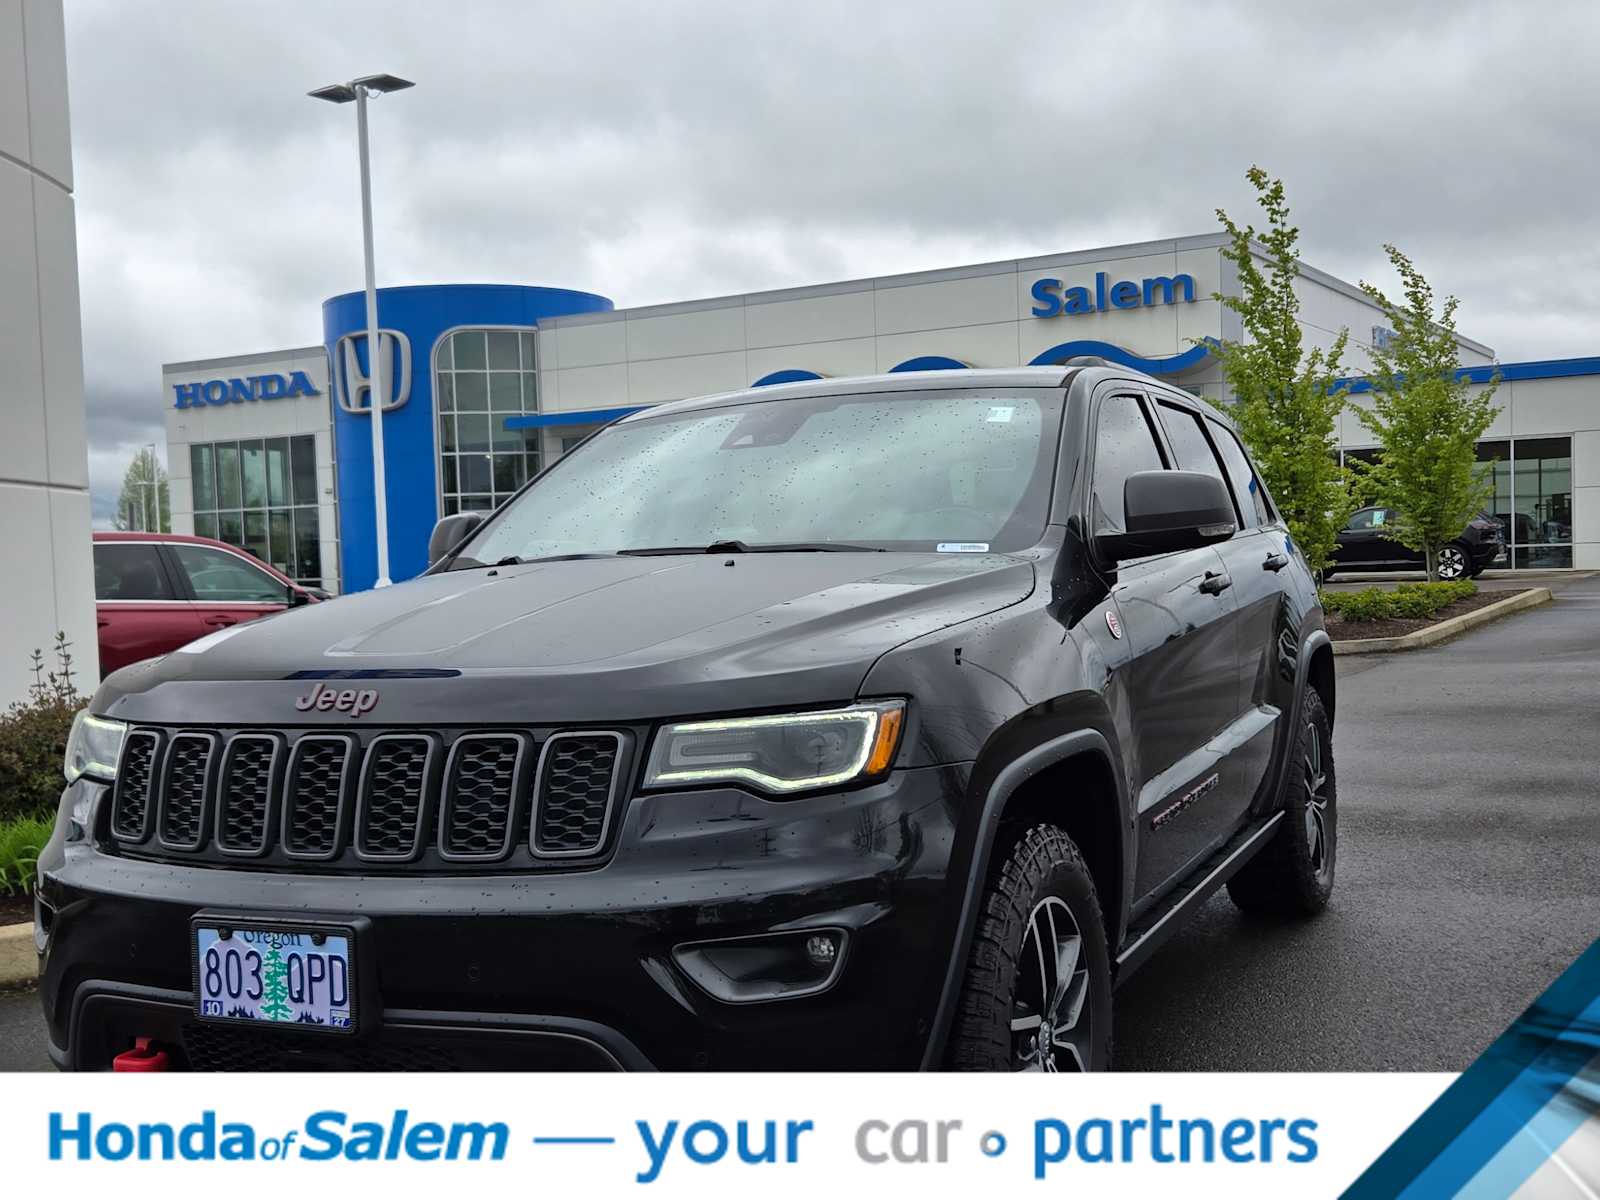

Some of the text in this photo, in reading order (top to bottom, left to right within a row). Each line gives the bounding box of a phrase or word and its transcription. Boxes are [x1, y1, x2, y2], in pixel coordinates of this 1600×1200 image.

[1031, 272, 1196, 318] Salem
[173, 371, 320, 409] HONDA
[295, 682, 379, 718] Jeep
[205, 948, 347, 1007] 803 QPD
[205, 1002, 221, 1015] 10
